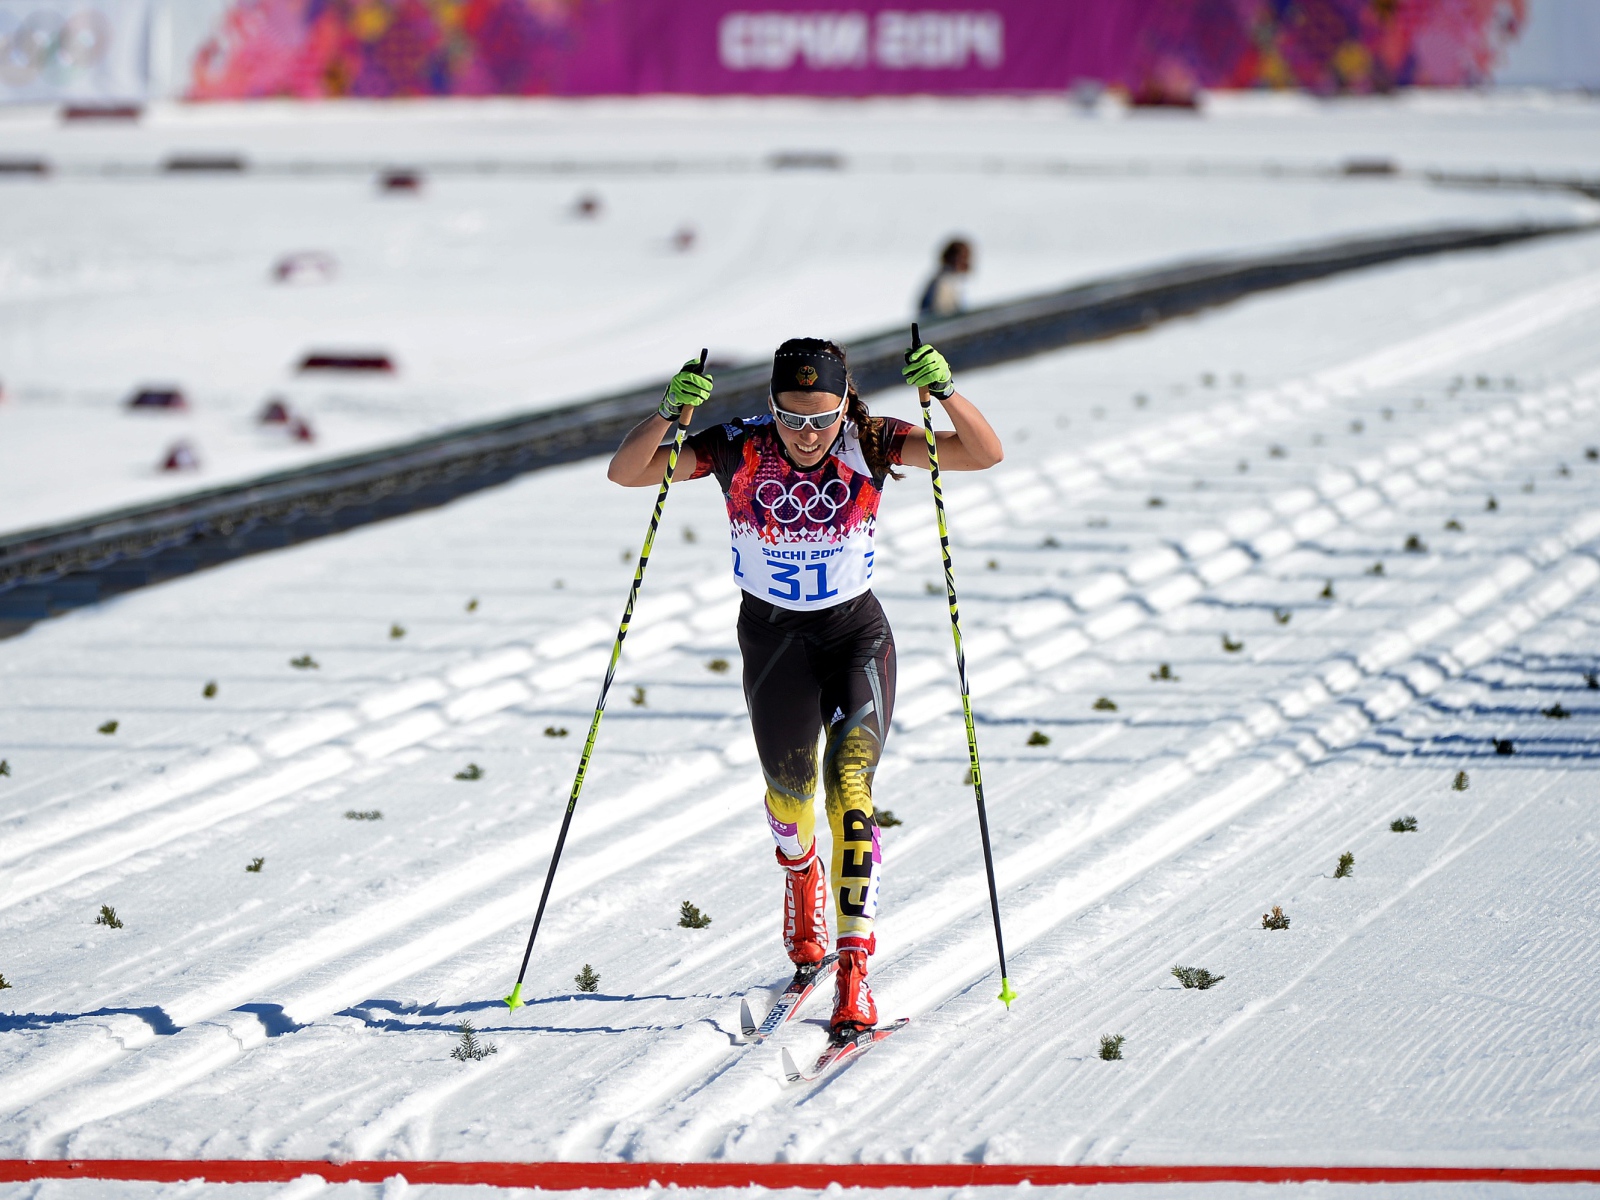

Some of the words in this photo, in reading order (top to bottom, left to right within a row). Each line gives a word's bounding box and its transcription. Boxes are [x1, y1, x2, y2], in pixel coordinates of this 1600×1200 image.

[876, 11, 1004, 70] 2014
[761, 547, 806, 560] SOCHI
[811, 546, 844, 560] 2014
[766, 560, 838, 602] 31
[839, 808, 876, 919] GER
